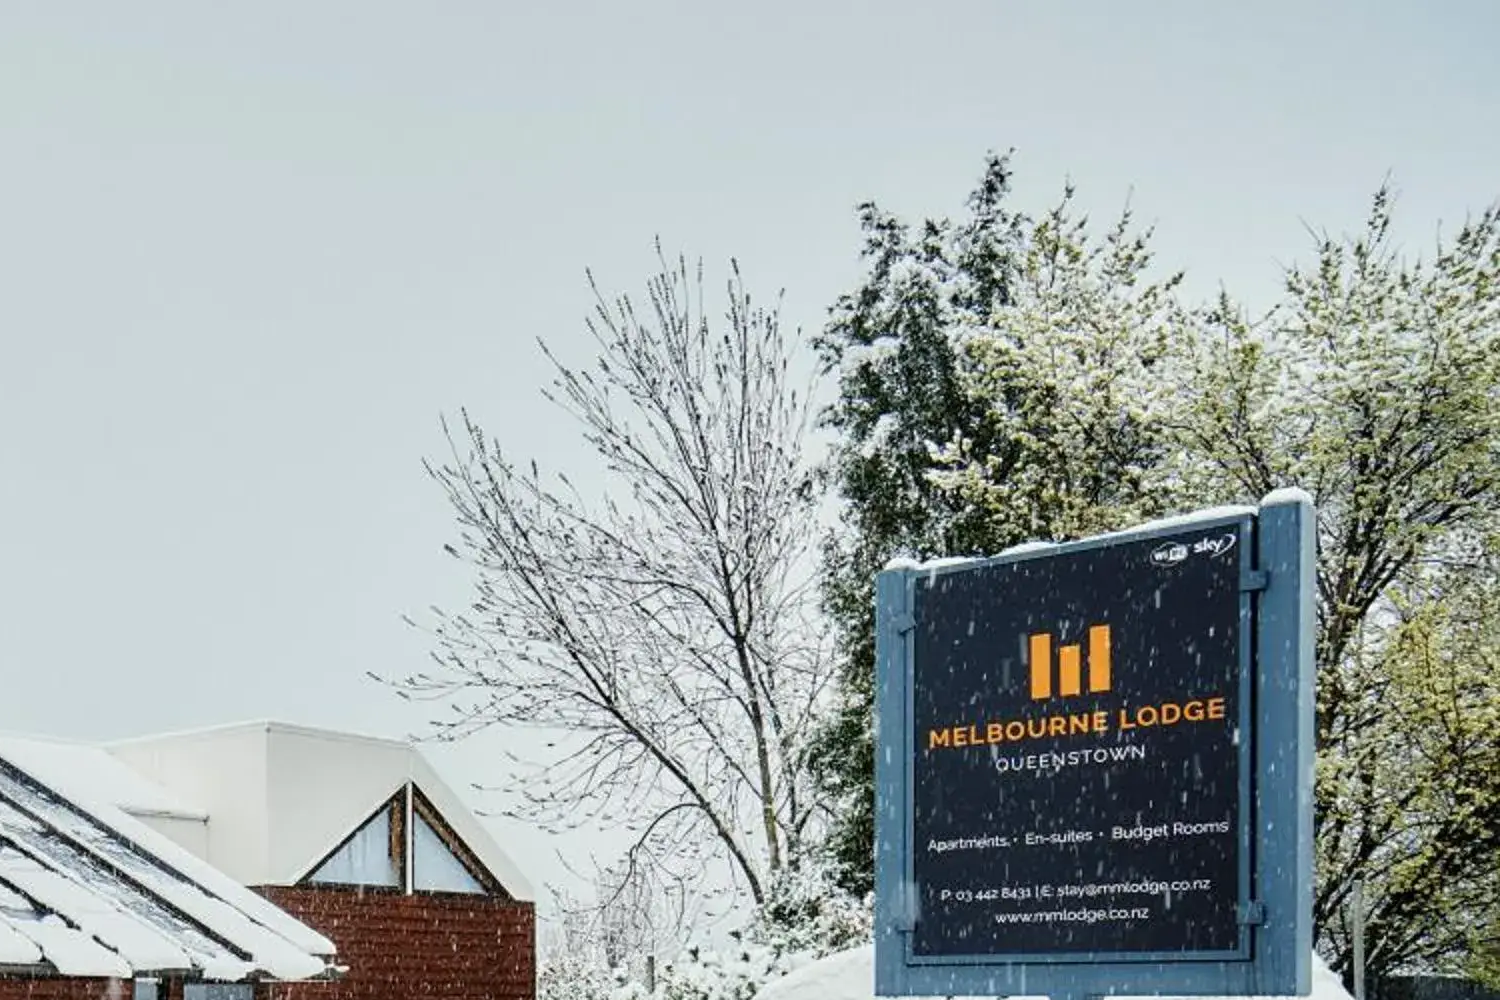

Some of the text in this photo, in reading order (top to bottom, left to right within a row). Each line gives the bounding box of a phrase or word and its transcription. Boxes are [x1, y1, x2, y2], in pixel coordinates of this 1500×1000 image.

[1193, 536, 1225, 554] sky
[929, 697, 1225, 749] MELBOURNE LODGE
[995, 744, 1146, 772] QUEENSTOWN
[927, 820, 1229, 853] Apartments En-suites Budget Rooms
[975, 889, 999, 900] 442
[1057, 878, 1211, 899] stay@mmlodge.co.nz
[995, 906, 1149, 924] www.mmlodge.co.nz
